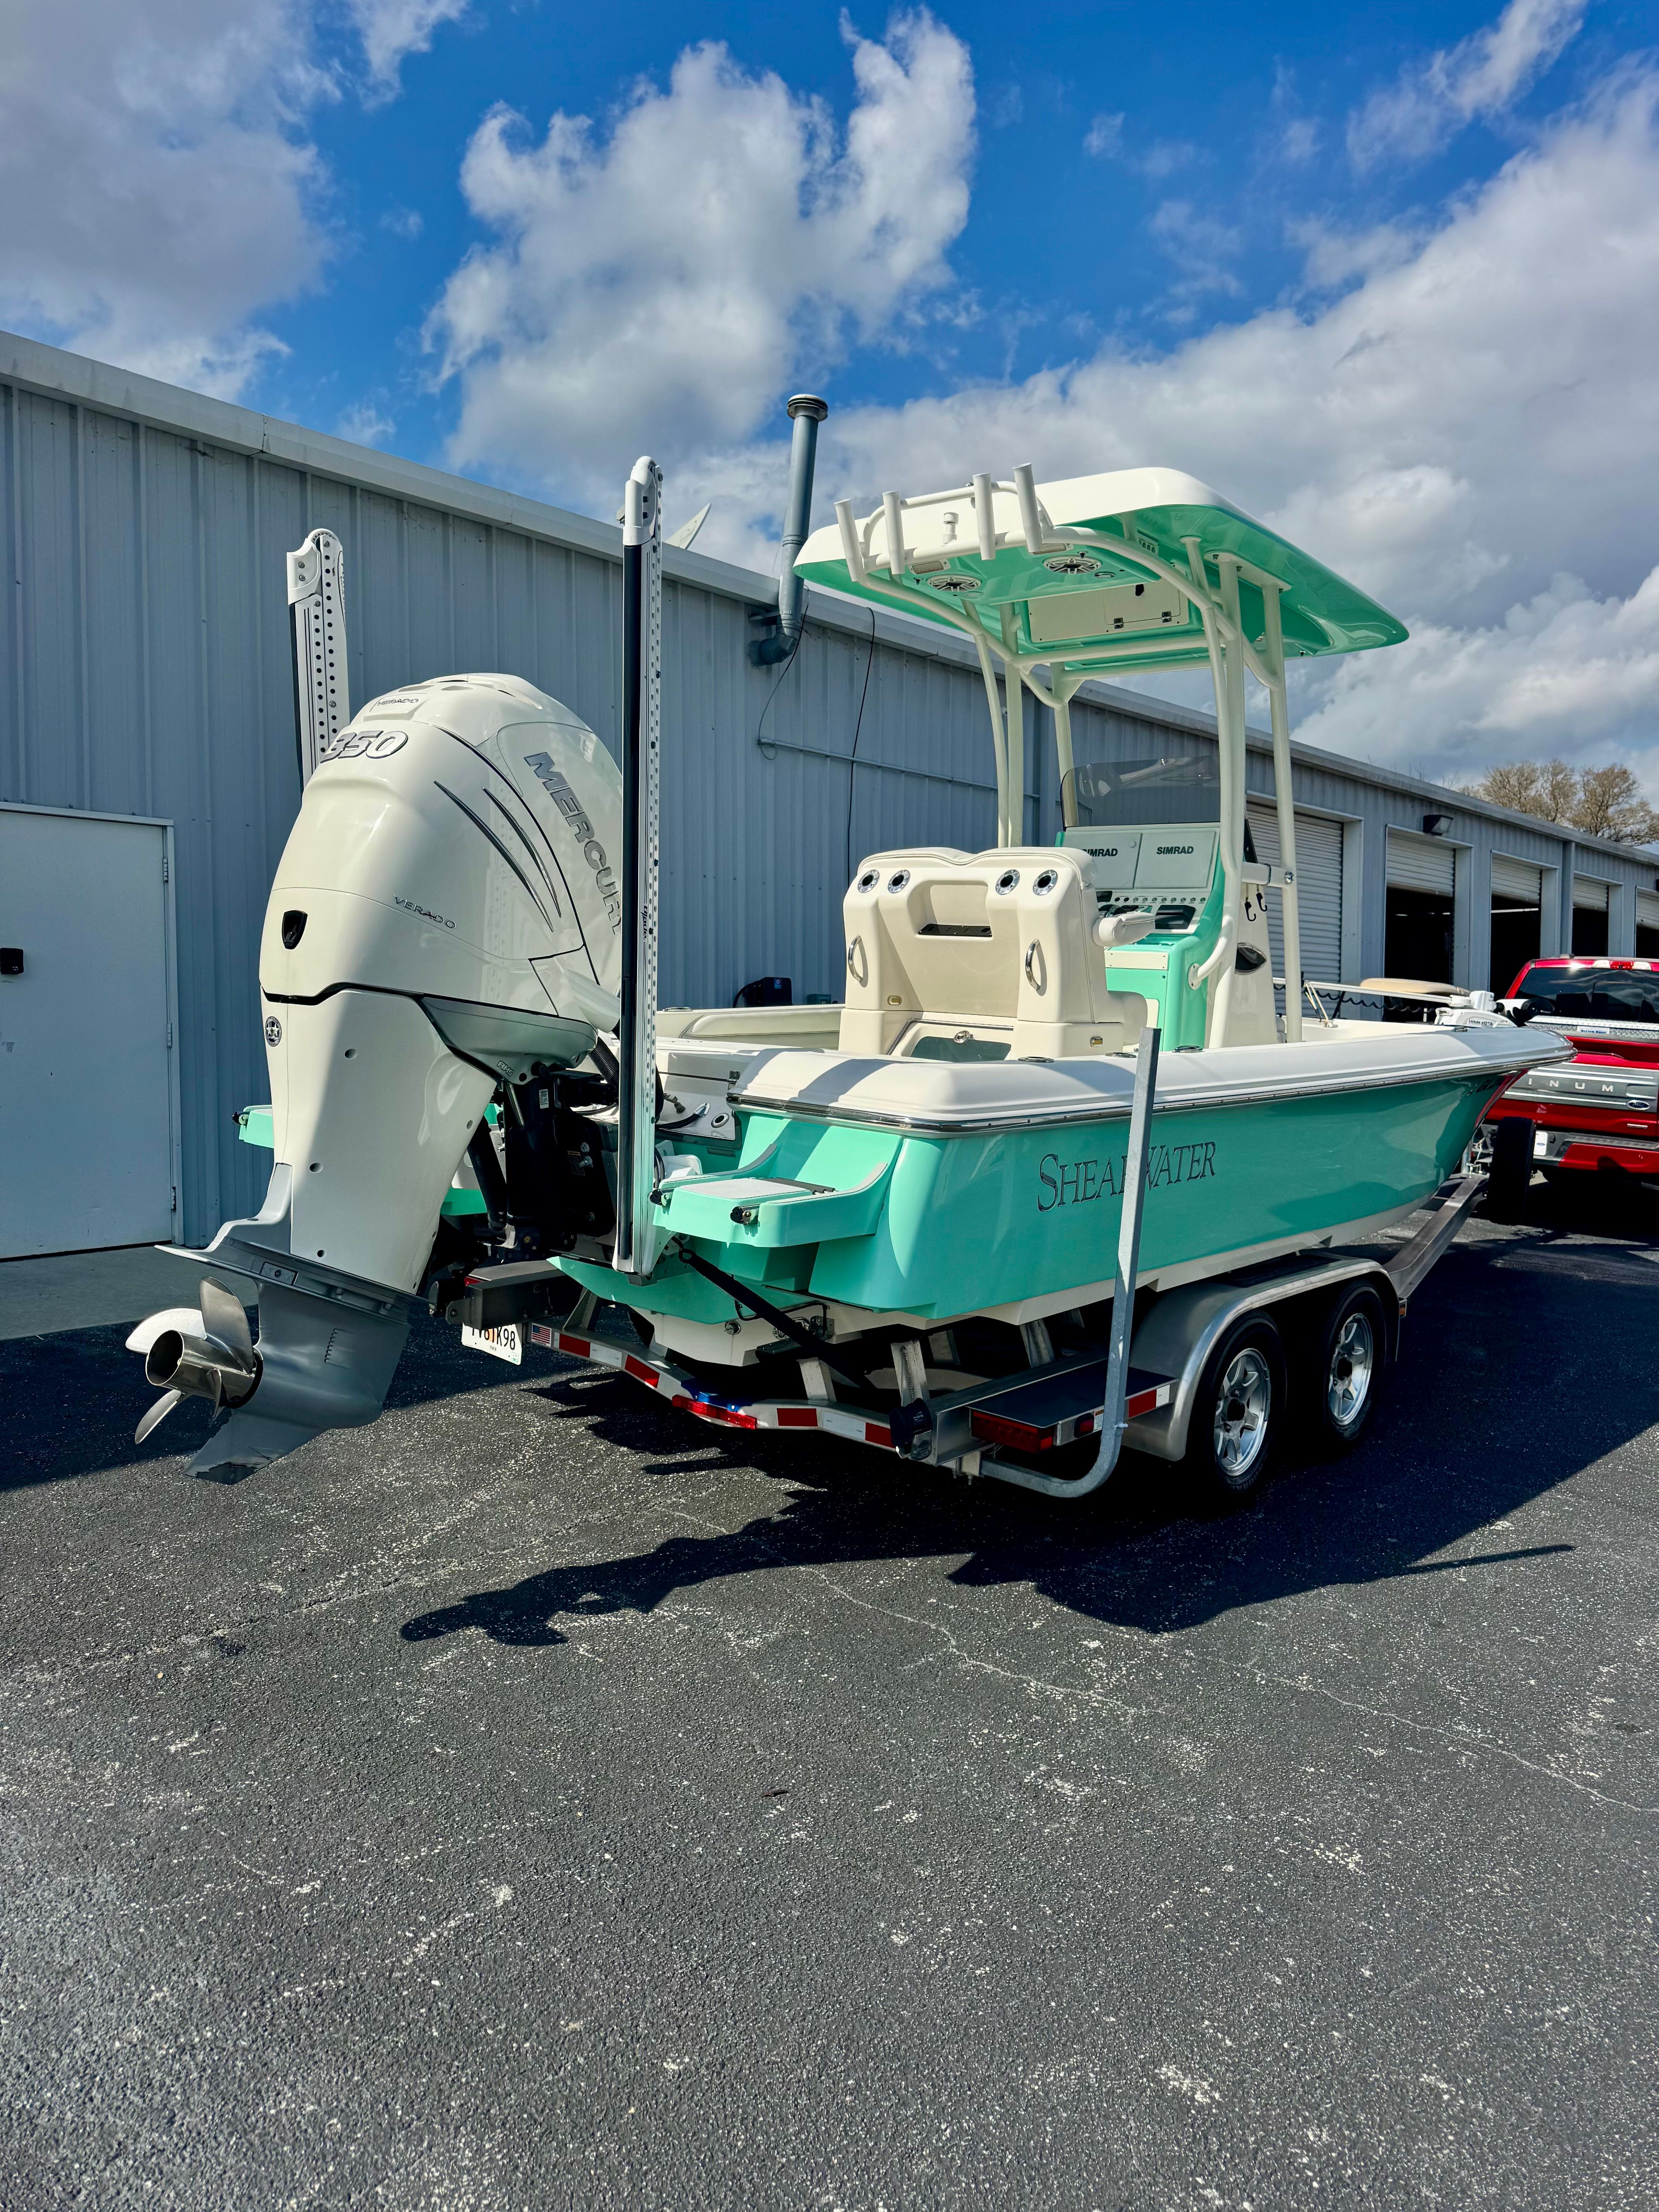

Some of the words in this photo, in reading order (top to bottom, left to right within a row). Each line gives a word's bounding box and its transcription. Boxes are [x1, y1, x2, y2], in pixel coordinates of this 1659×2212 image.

[319, 730, 409, 764] 350
[1156, 846, 1194, 855] SIMRAD
[394, 894, 456, 929] VERADO
[1528, 1078, 1614, 1092] INUM
